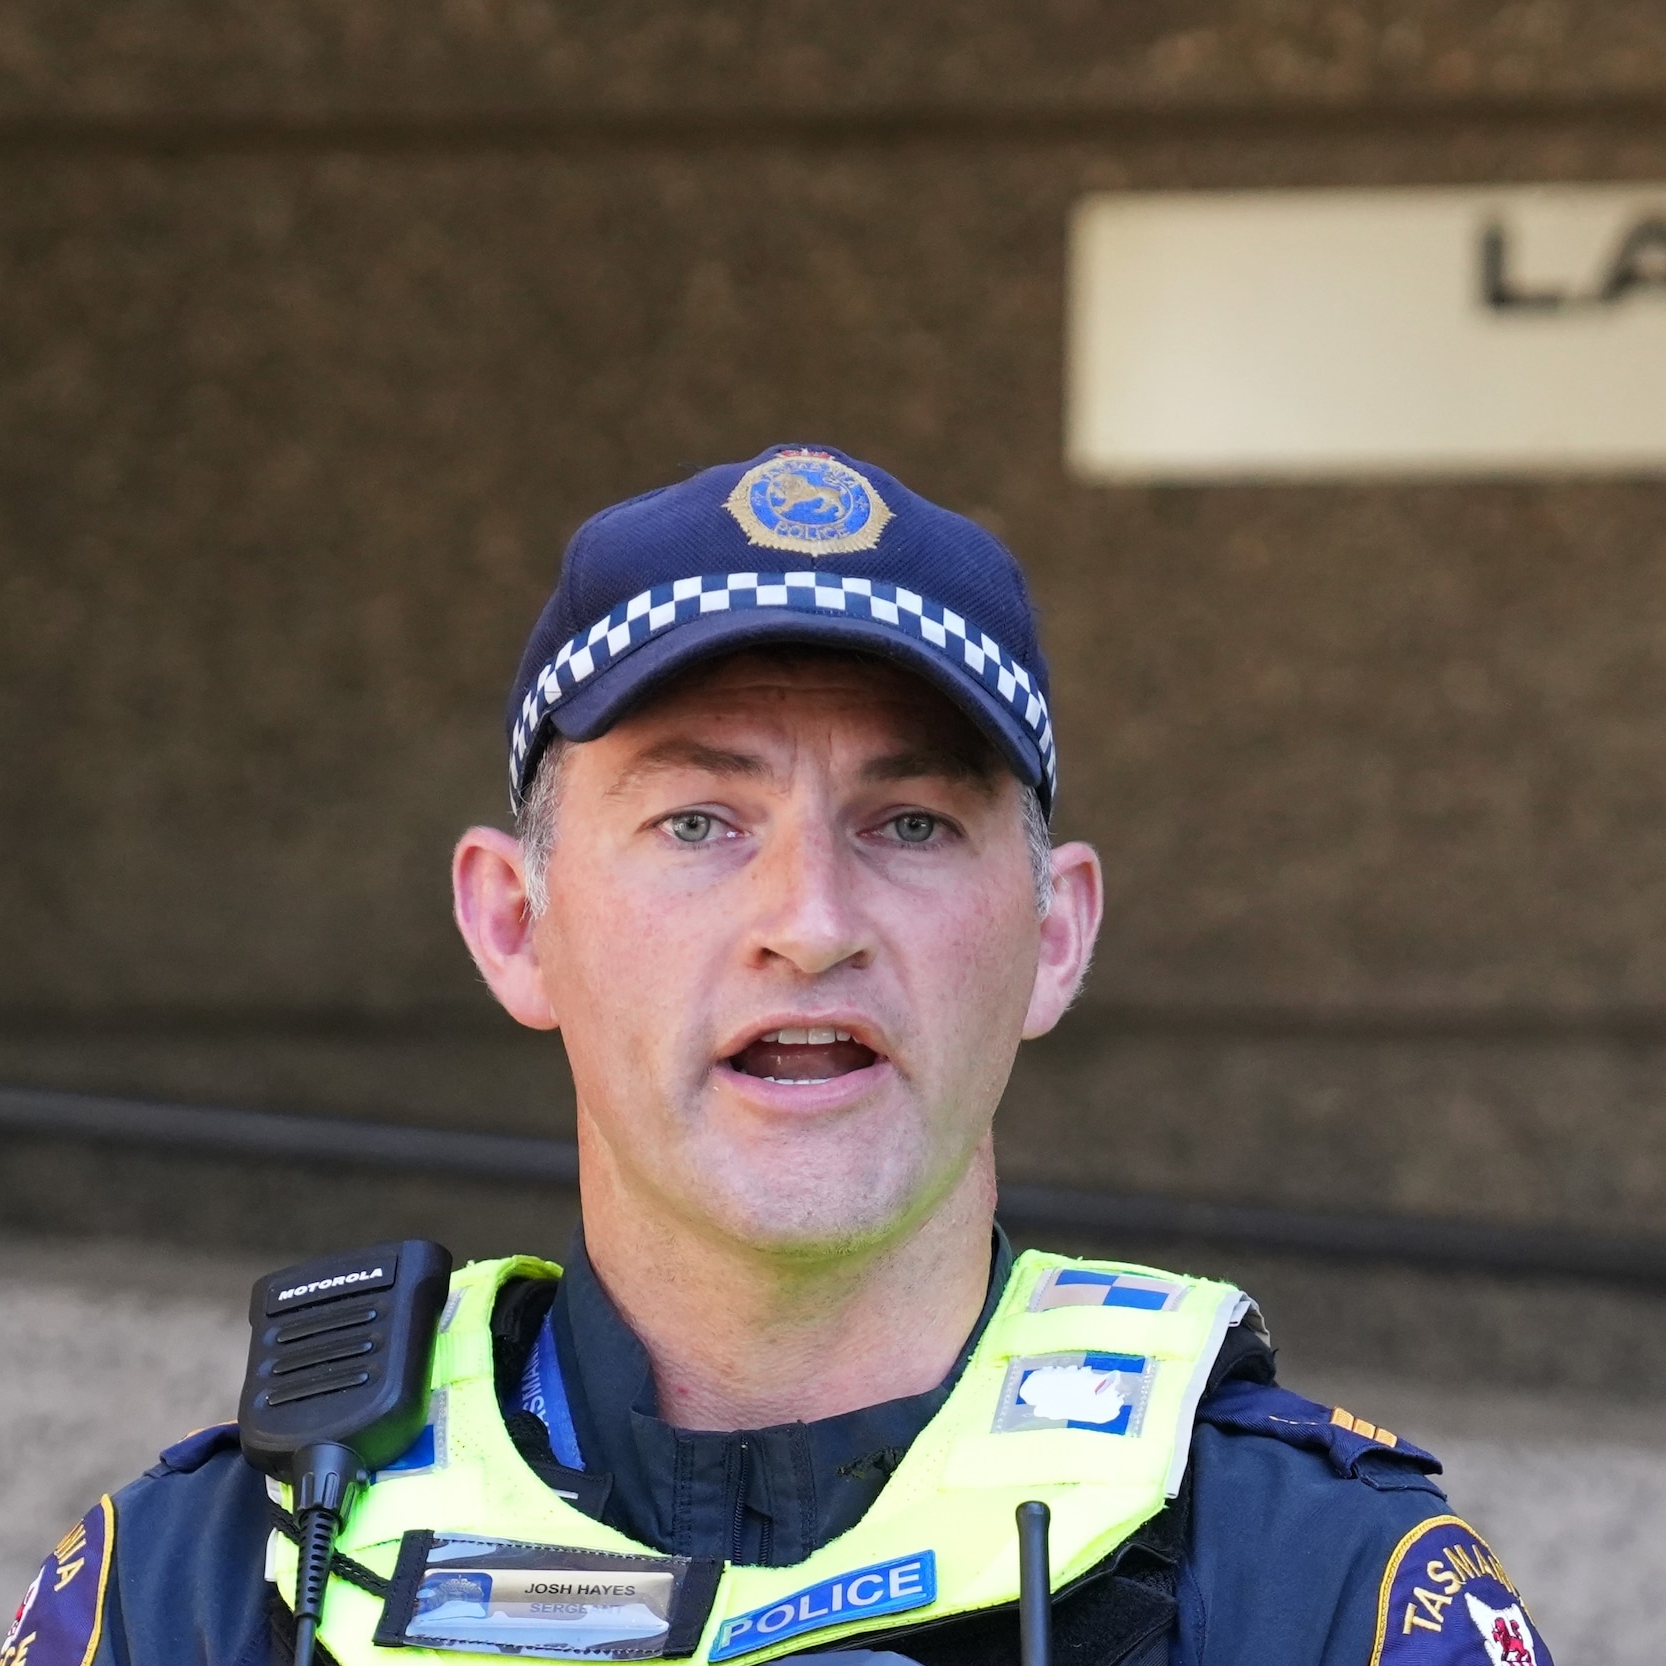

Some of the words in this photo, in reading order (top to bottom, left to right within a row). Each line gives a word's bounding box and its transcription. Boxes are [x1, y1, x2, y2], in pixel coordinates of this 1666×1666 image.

[774, 520, 850, 540] POLICE
[278, 1268, 383, 1301] MOTOROLA
[524, 1582, 571, 1596] JOSH
[577, 1583, 636, 1597] HAYES
[719, 1561, 924, 1649] POLICE
